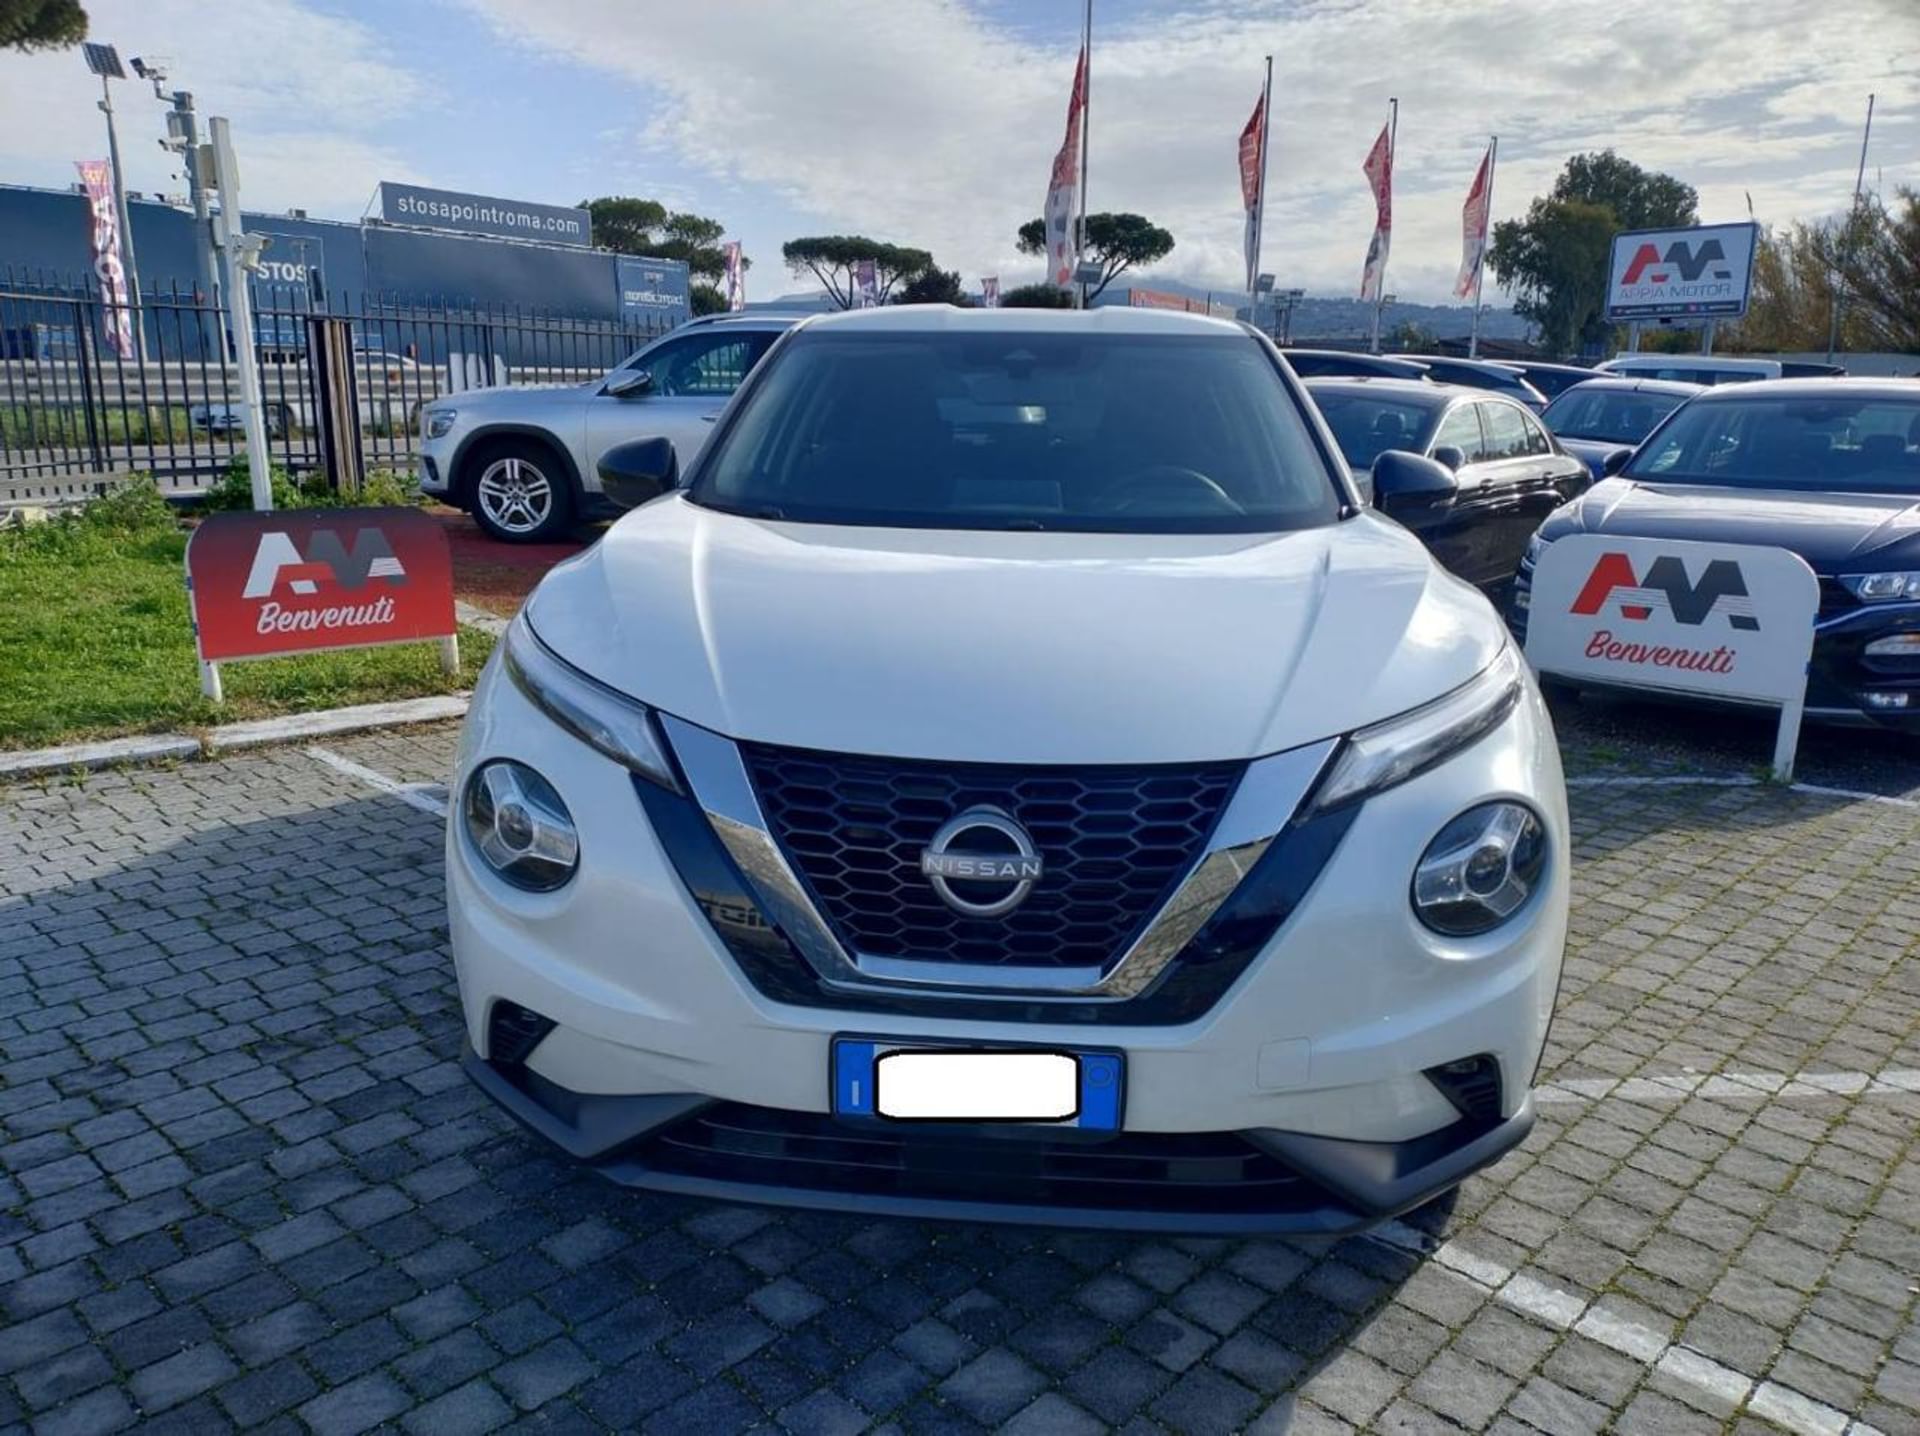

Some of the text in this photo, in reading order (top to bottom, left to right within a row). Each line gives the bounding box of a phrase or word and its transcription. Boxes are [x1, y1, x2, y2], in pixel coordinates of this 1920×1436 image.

[397, 195, 580, 234] stosapointroma.com
[1620, 283, 1731, 299] APPIA MOTOR
[256, 595, 395, 634] Benvenuti
[1584, 629, 1737, 674] Benvenuti
[926, 856, 1041, 877] NISSAN
